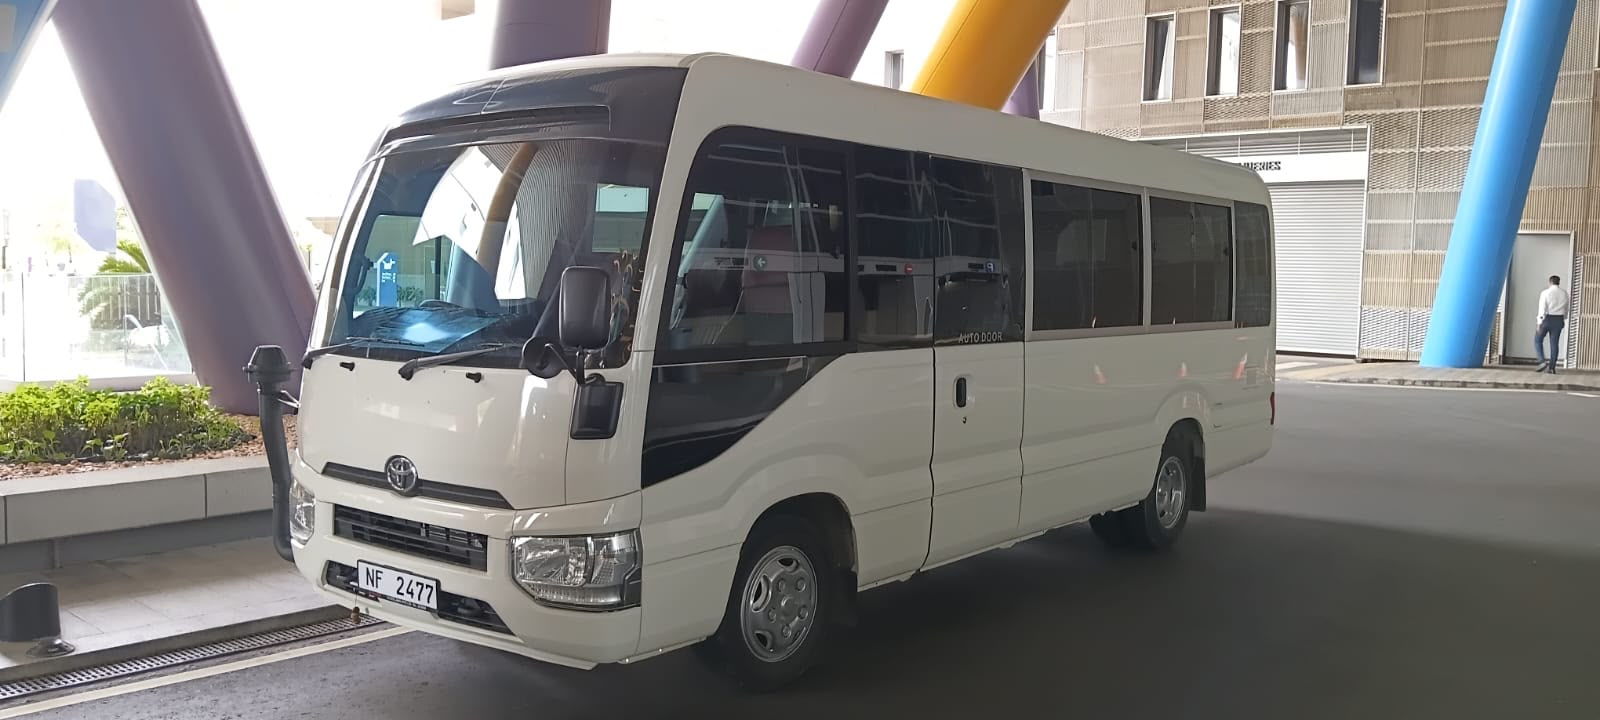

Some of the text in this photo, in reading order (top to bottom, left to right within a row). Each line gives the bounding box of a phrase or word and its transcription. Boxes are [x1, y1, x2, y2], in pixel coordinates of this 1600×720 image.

[959, 331, 1003, 344] AUTO DOOR
[365, 566, 384, 589] NF
[396, 575, 434, 604] 2477
